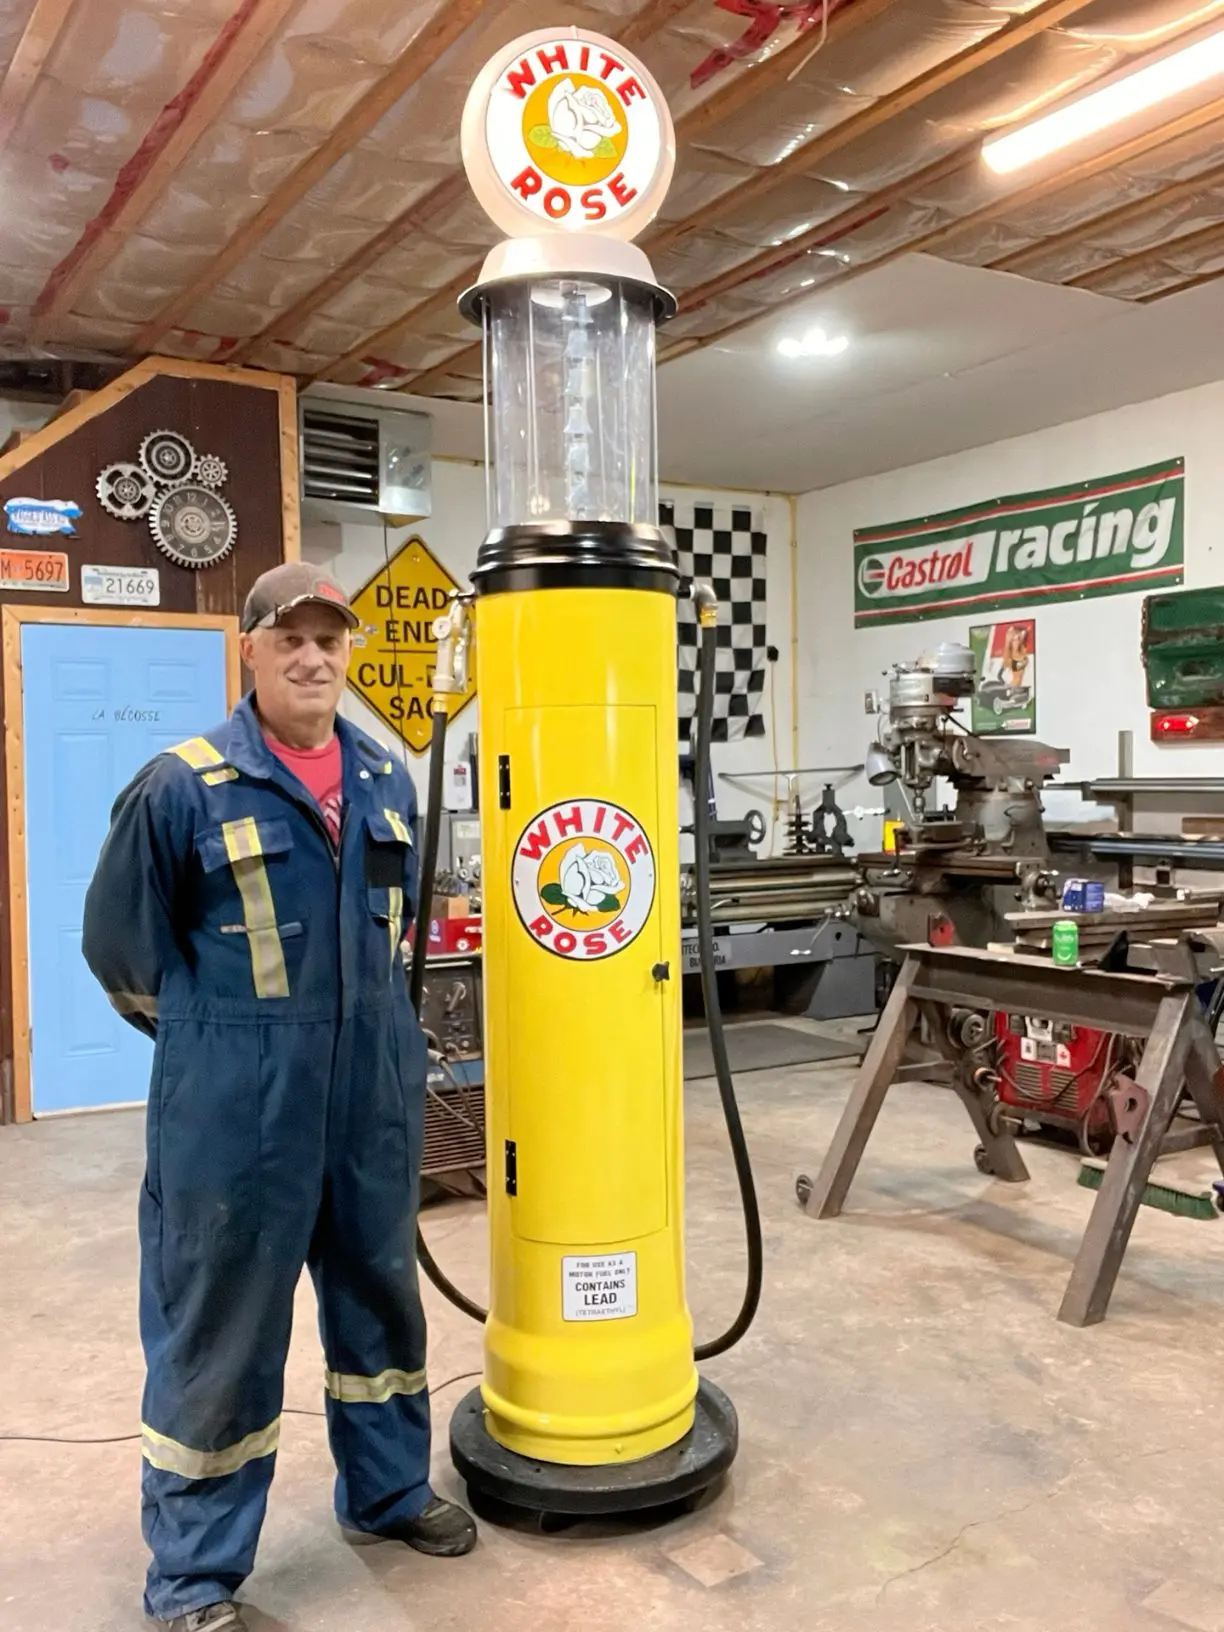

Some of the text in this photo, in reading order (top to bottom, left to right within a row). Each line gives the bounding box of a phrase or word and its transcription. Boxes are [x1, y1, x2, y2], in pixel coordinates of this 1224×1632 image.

[504, 45, 646, 107] WHITE
[510, 166, 638, 220] ROSE
[886, 497, 1176, 591] Castrol racing
[24, 559, 63, 582] 5697
[106, 577, 154, 594] 21669
[376, 585, 448, 610] DEAD
[520, 806, 648, 864] WHITE
[529, 915, 632, 955] ROSE
[595, 1269, 612, 1278] FUEL
[614, 1267, 631, 1276] ONLY
[575, 1279, 626, 1292] CONTAINS
[584, 1292, 617, 1305] LEAD
